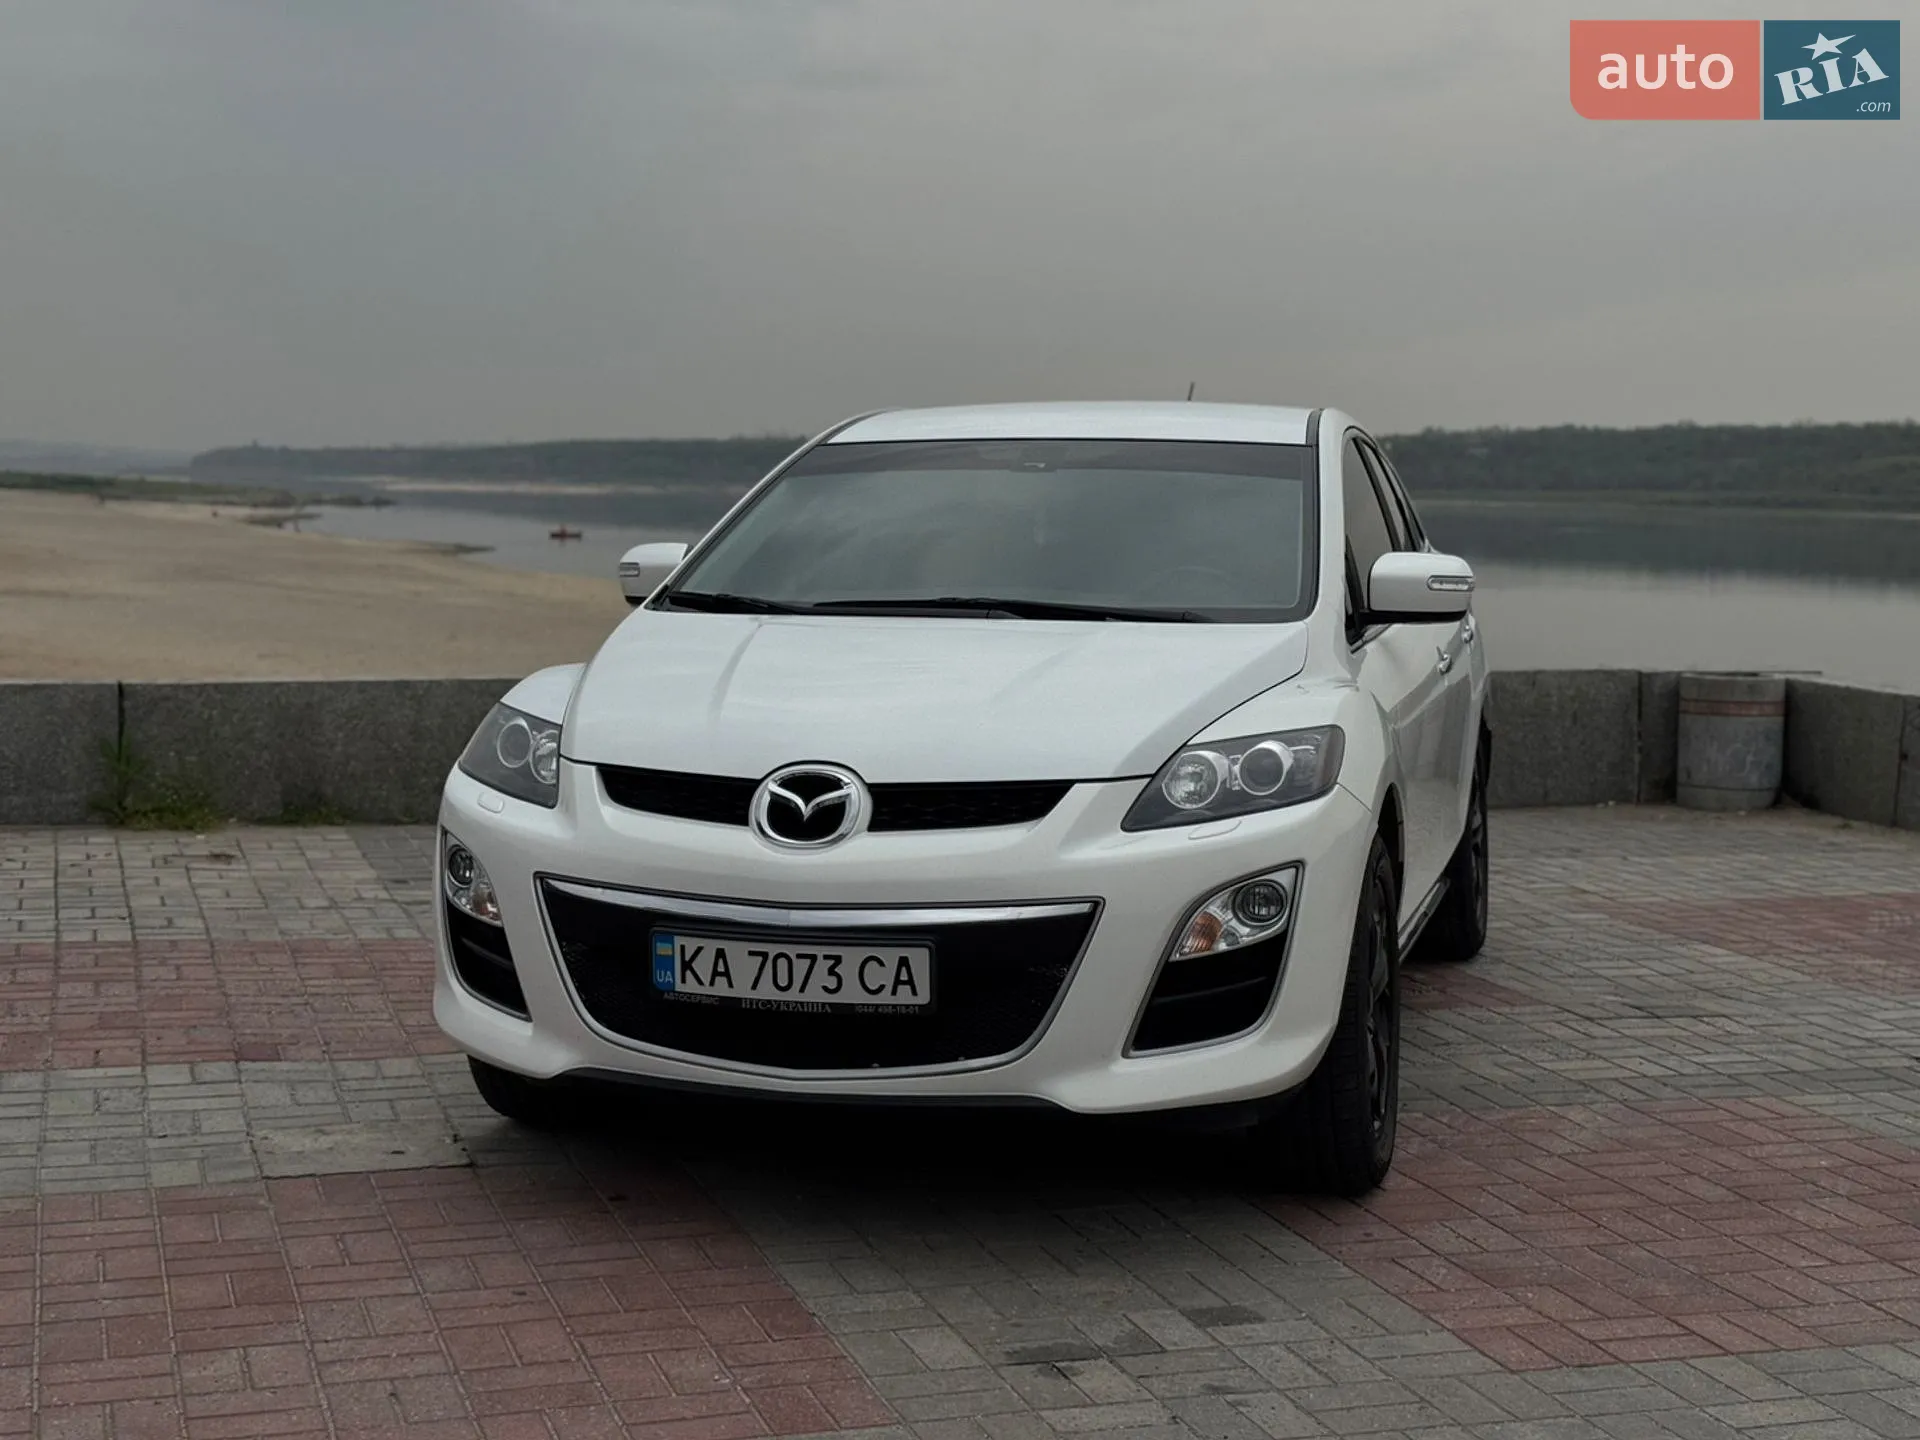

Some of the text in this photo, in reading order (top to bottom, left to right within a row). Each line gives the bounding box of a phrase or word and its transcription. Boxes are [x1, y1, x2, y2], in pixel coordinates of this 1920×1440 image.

[656, 969, 673, 982] UA
[679, 944, 918, 997] KA 7073 CA
